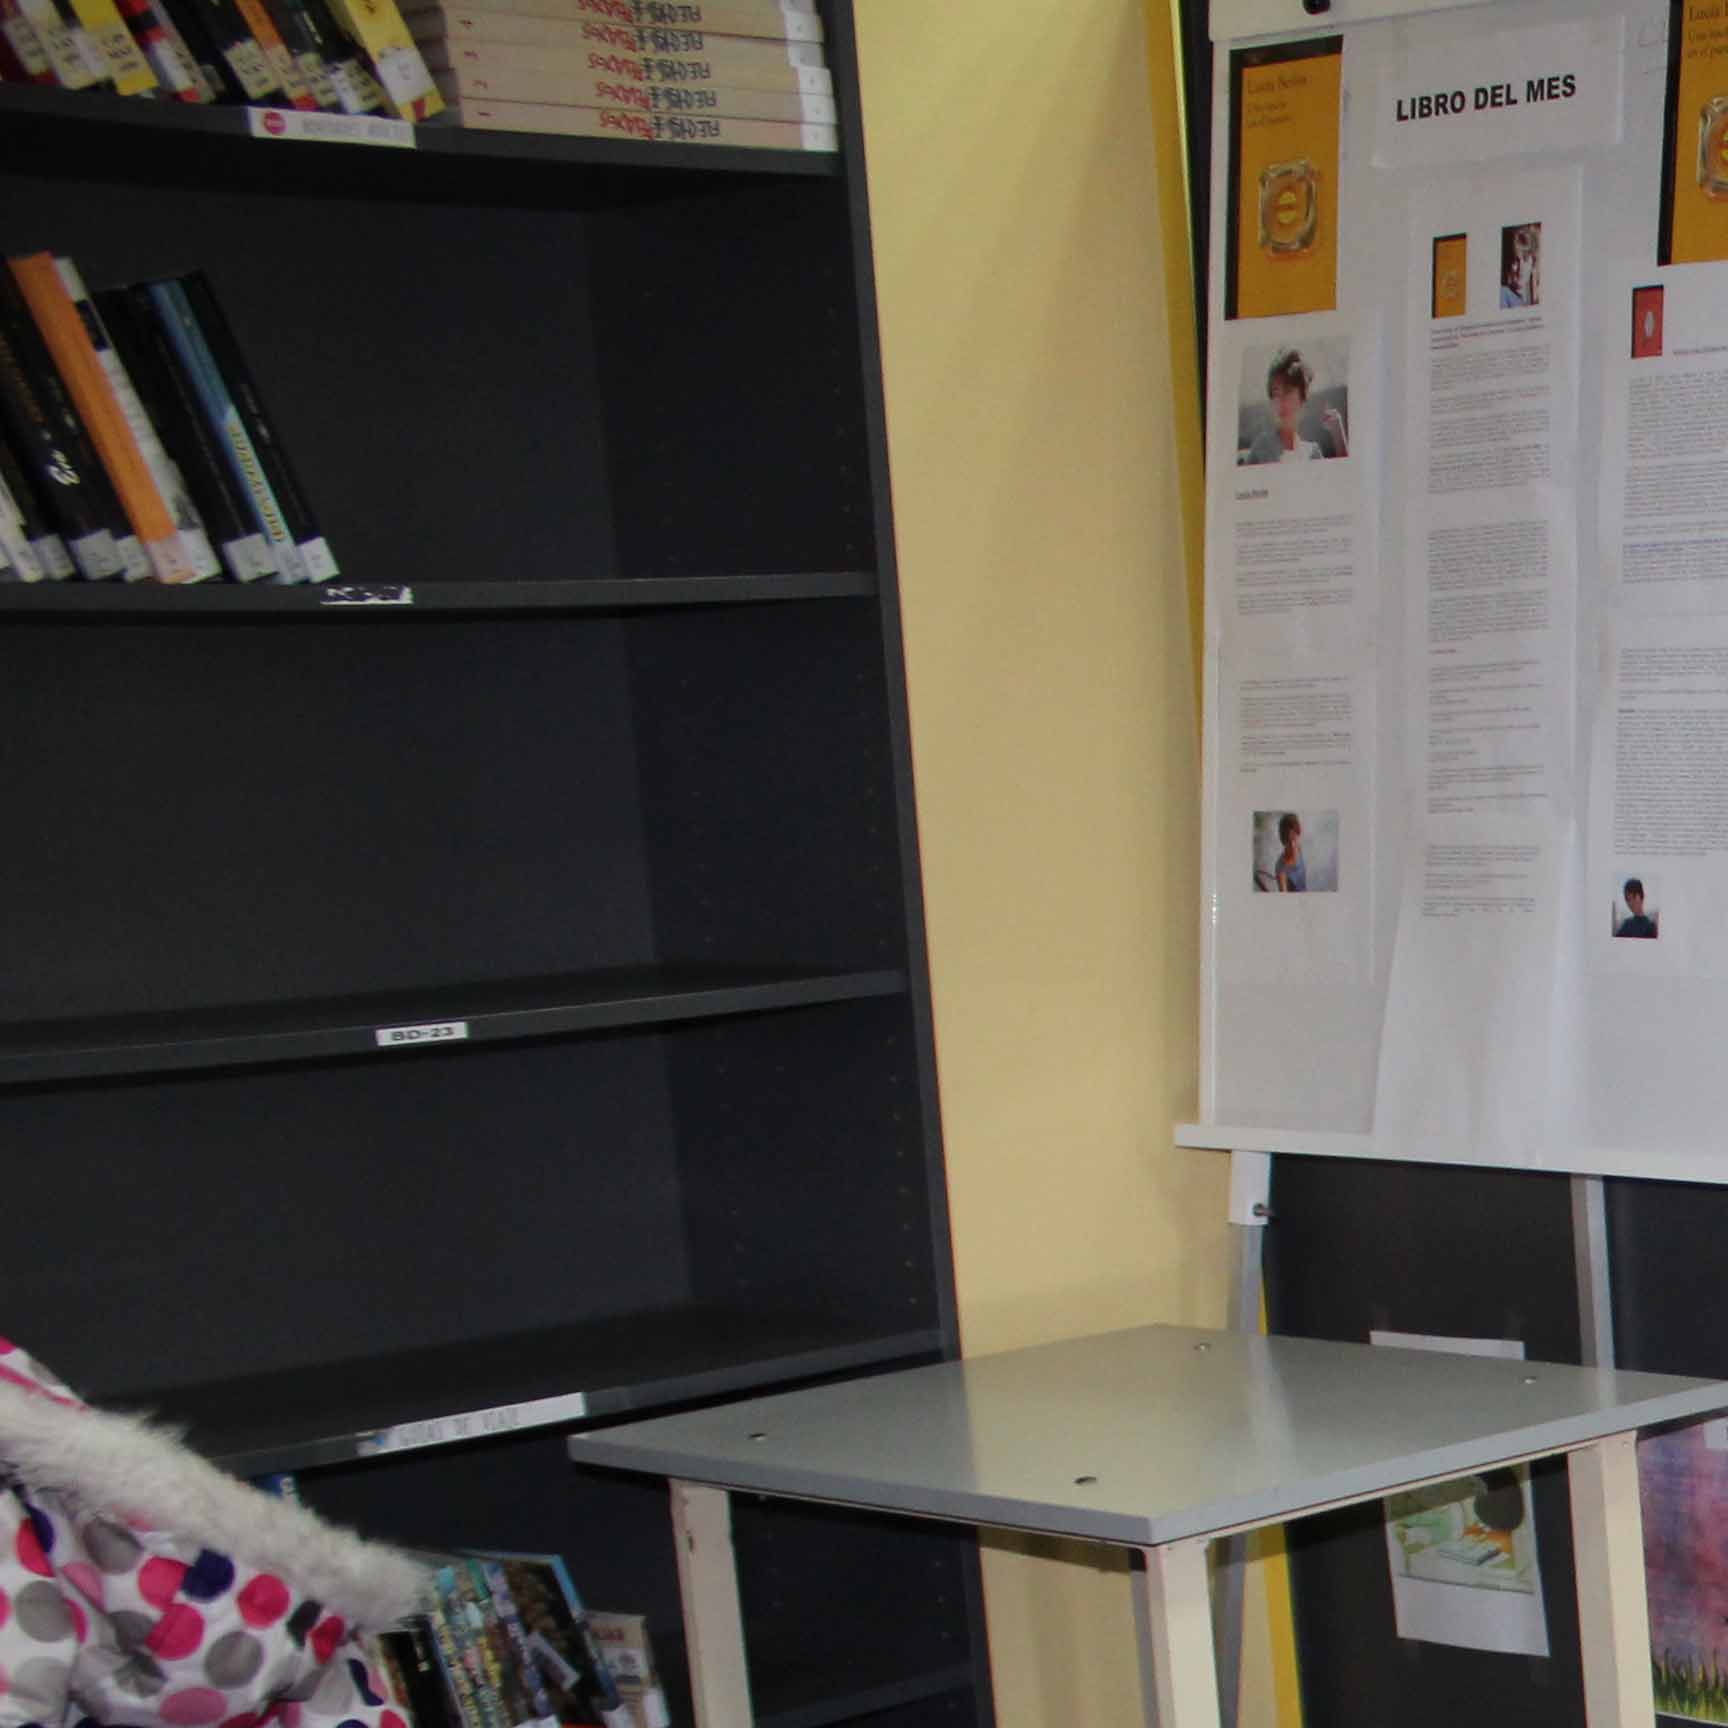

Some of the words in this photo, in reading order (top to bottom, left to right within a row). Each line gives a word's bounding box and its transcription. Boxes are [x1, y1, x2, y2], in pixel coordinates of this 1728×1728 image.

[1395, 90, 1467, 122] LIBRO
[1474, 83, 1519, 110] DEL
[1526, 74, 1577, 102] MES
